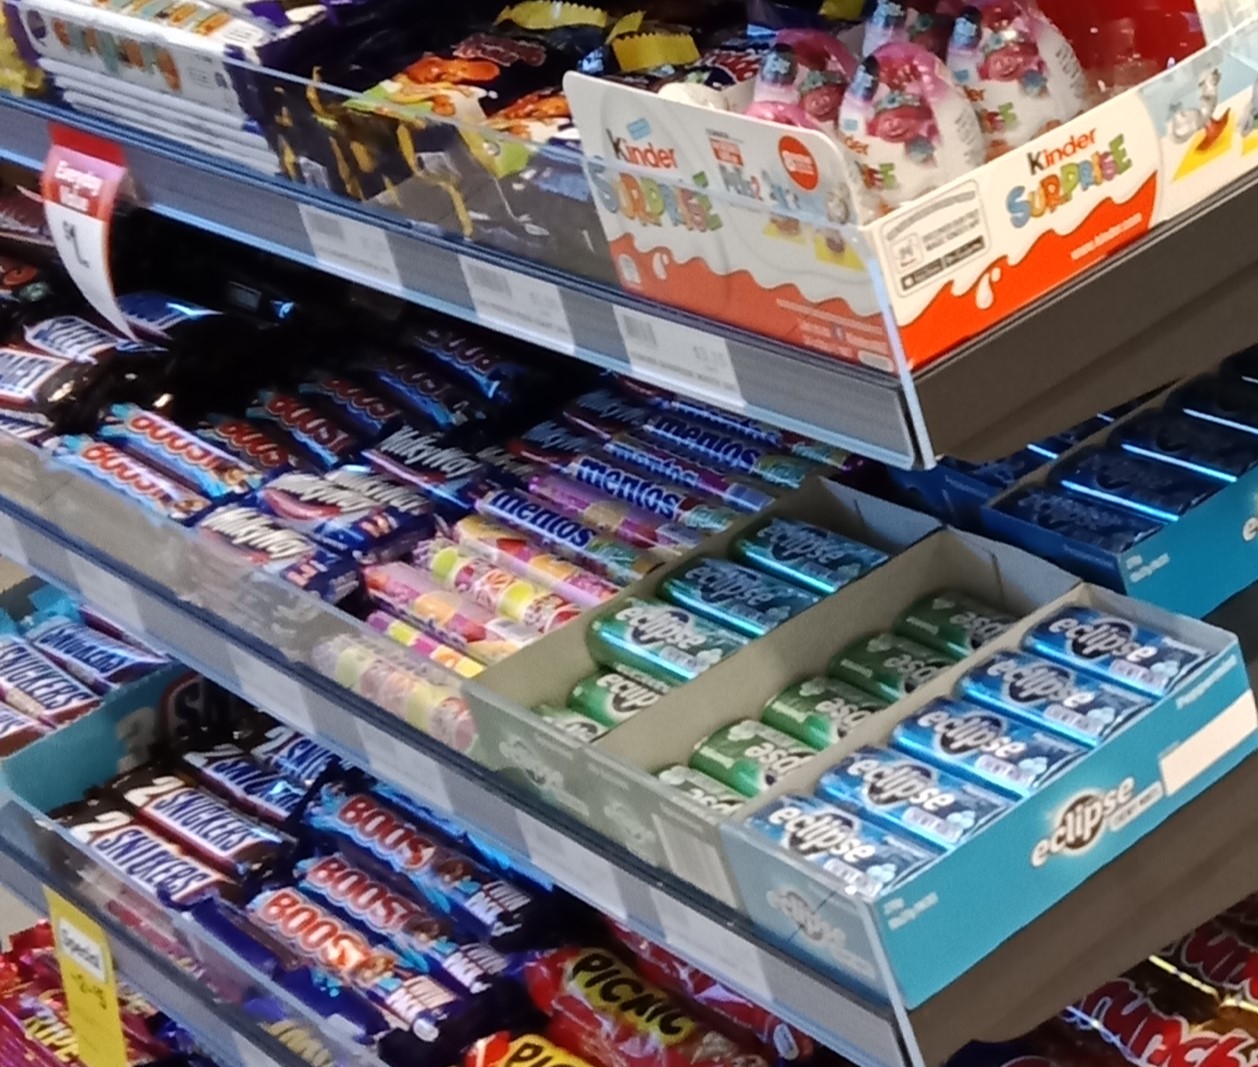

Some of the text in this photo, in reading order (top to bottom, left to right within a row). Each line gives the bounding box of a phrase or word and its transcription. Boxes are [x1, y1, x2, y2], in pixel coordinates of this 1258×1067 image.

[1006, 133, 1133, 229] SURPRISE
[614, 604, 707, 651] eclipse
[1049, 617, 1158, 662] eclipse
[987, 657, 1096, 708] eclipse
[917, 710, 1027, 757] eclipse
[847, 757, 956, 811] eclipse
[152, 786, 254, 853] SNICKERS
[768, 806, 877, 863] eclipse
[1030, 776, 1135, 868] eclipse
[570, 951, 692, 1036] PICNIC
